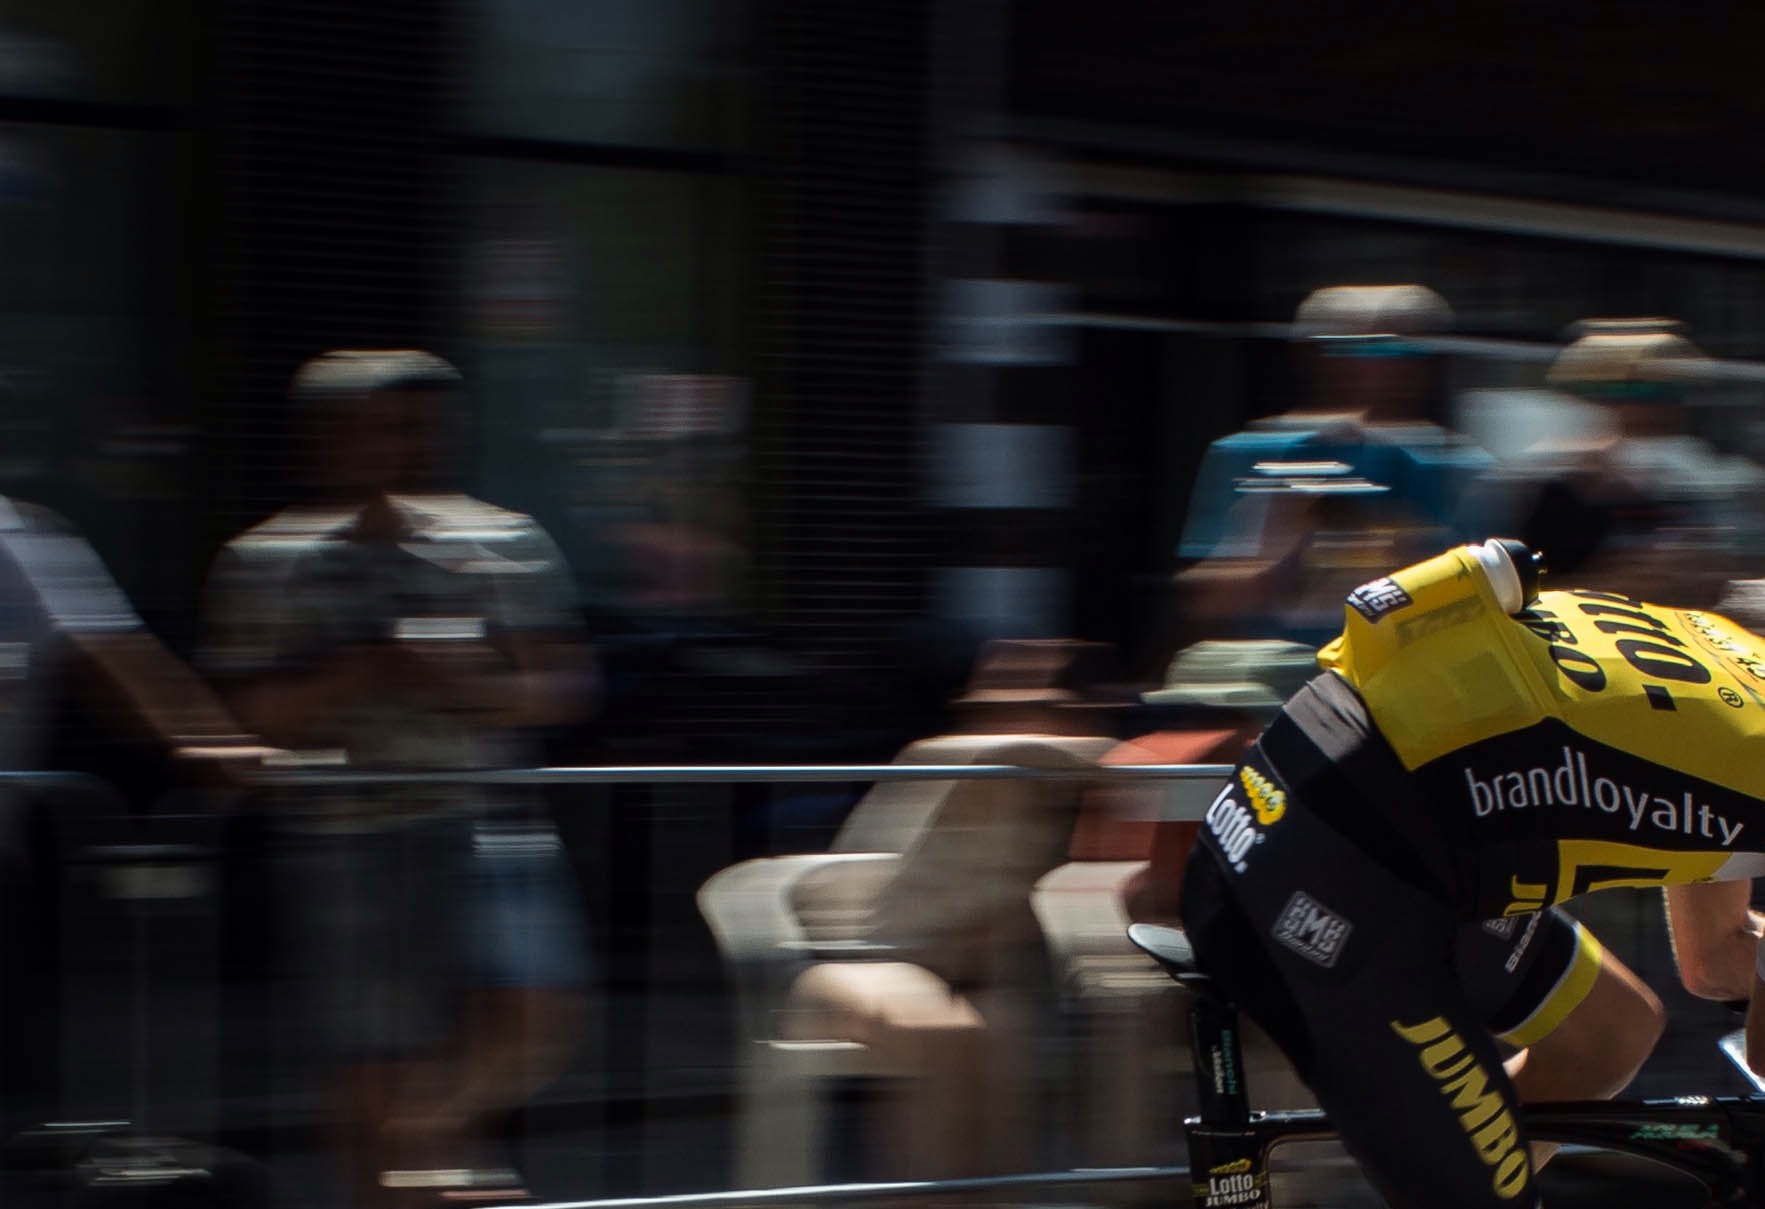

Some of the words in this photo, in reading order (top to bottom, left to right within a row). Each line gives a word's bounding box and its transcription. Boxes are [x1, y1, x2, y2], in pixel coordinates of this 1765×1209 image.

[1465, 746, 1745, 847] brandloyalty
[1392, 1016, 1529, 1199] JUMBO
[1205, 1189, 1262, 1207] JUMBO
[1209, 1173, 1254, 1196] Lotto
